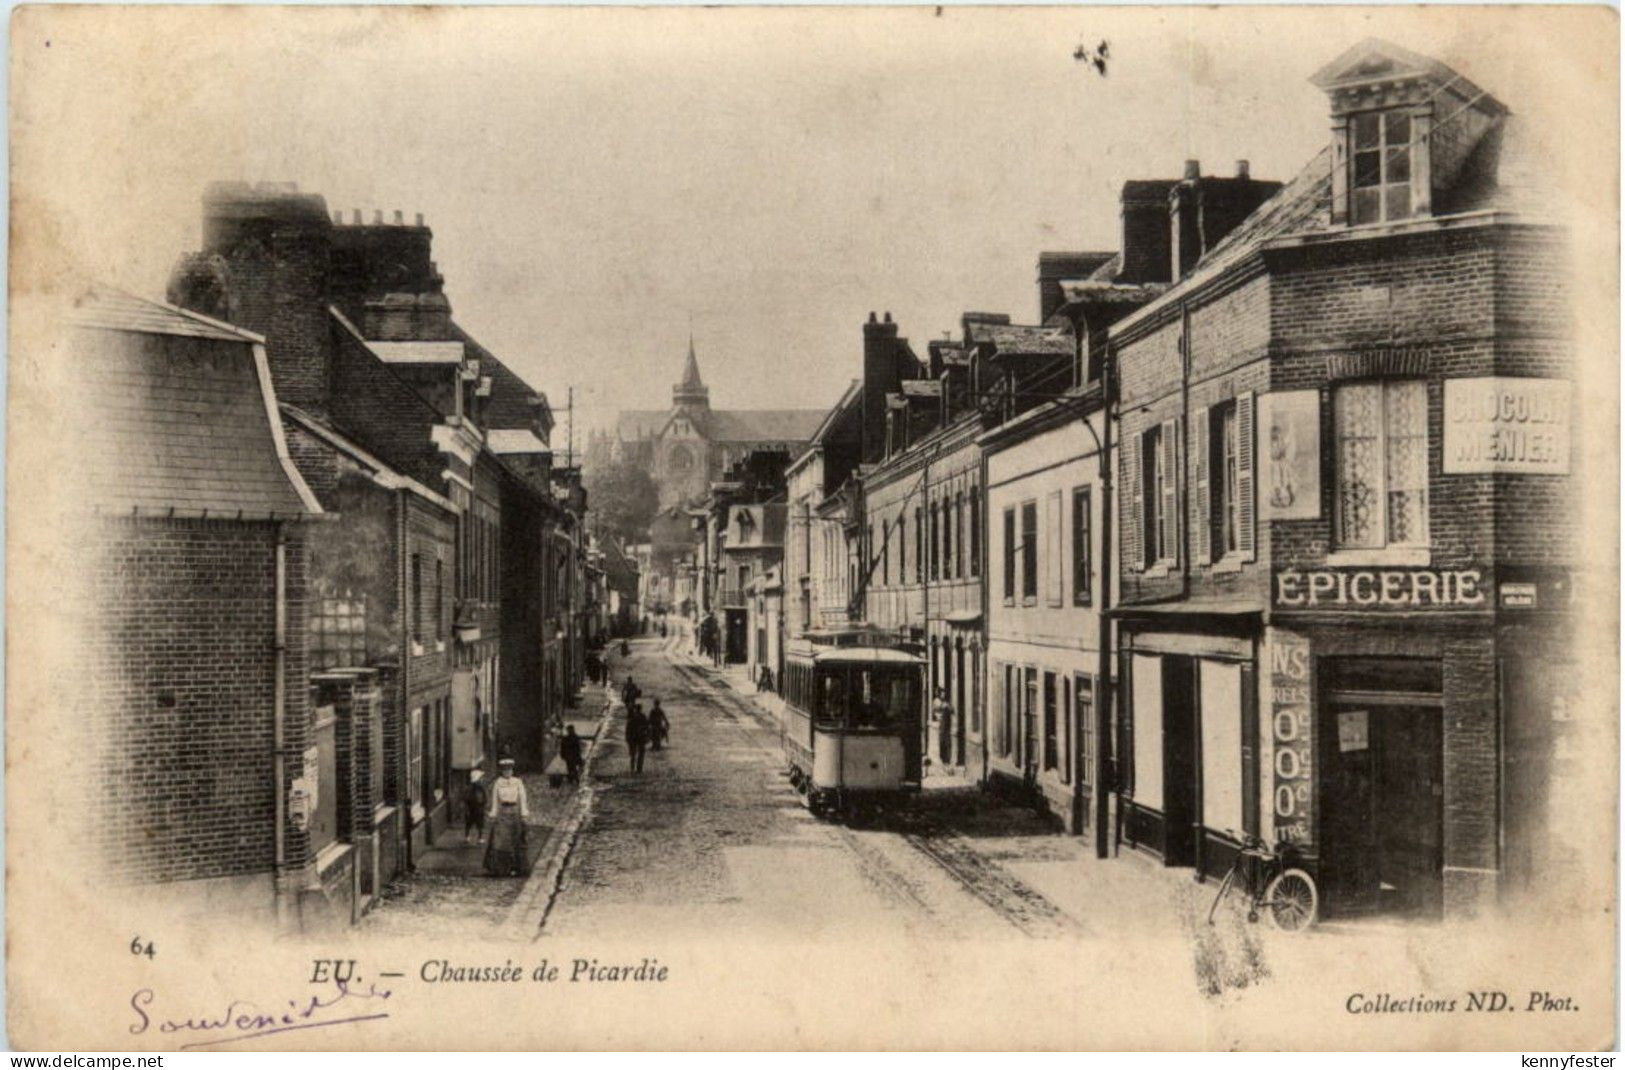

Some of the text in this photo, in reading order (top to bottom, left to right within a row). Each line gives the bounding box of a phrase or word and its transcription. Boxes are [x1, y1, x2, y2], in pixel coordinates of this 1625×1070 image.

[1454, 430, 1561, 463] MENIER
[1276, 567, 1485, 606] ÉPICERIE
[130, 937, 157, 960] 64
[309, 960, 364, 983] EU.
[420, 959, 522, 983] Chaussée
[533, 959, 559, 983] de
[570, 959, 669, 983] Picardie
[1345, 991, 1580, 1014] Collections ND. Phot.
